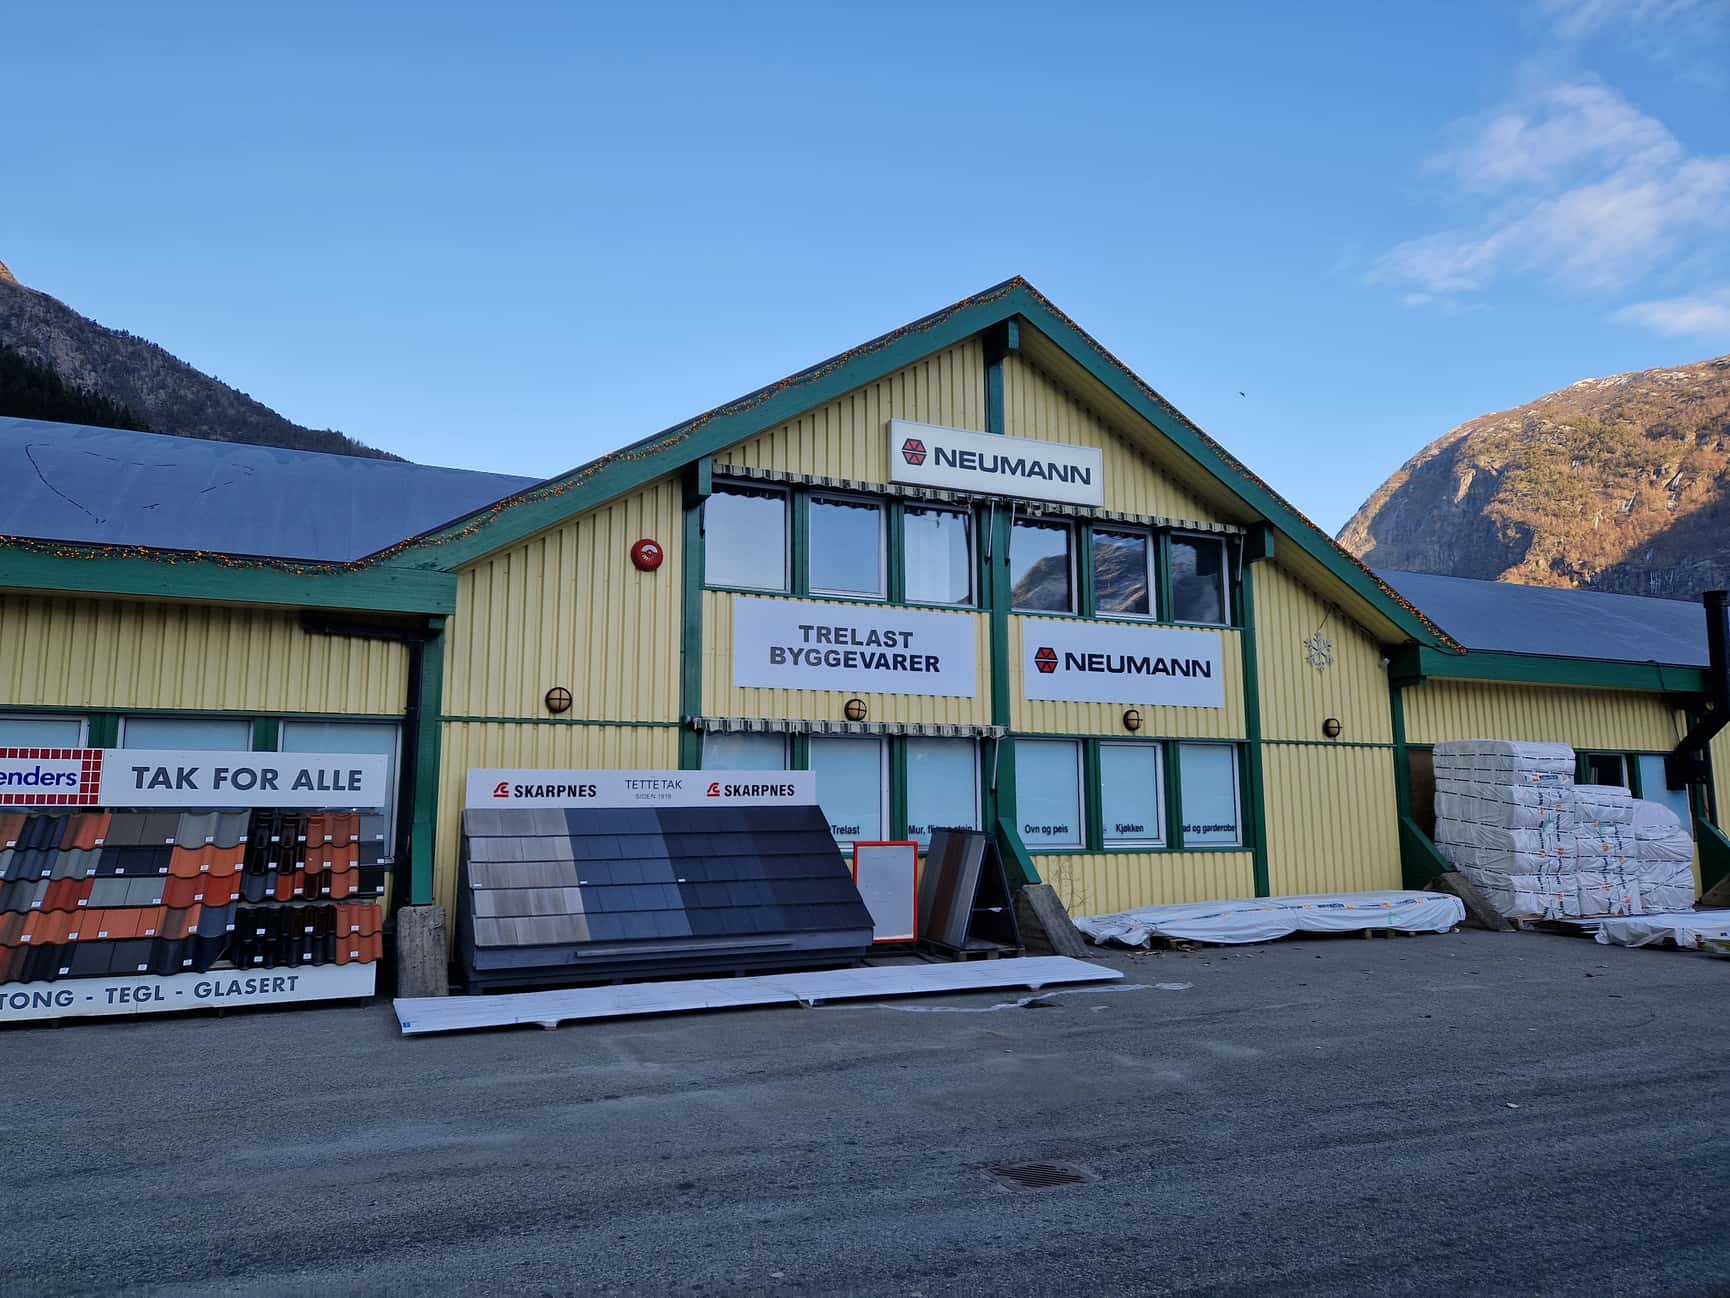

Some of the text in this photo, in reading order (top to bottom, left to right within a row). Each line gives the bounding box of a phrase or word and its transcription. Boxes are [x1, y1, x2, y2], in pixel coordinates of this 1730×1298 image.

[934, 447, 1091, 485] NEUMANN
[798, 625, 914, 648] TRELAST
[769, 646, 940, 673] BYGGEVARER
[1064, 652, 1212, 678] NEUMANN
[131, 766, 363, 791] TAK FOR ALLE
[624, 779, 682, 790] TETTE TAK
[514, 784, 597, 798] SKARPNES
[724, 784, 795, 797] SKARPNES
[831, 824, 860, 835] Trelast
[1024, 824, 1069, 835] Ovn og peis
[1115, 824, 1144, 835] Kjøkken
[1192, 825, 1201, 834] og
[105, 985, 165, 1004] TEGL
[194, 975, 299, 998] GLASERT
